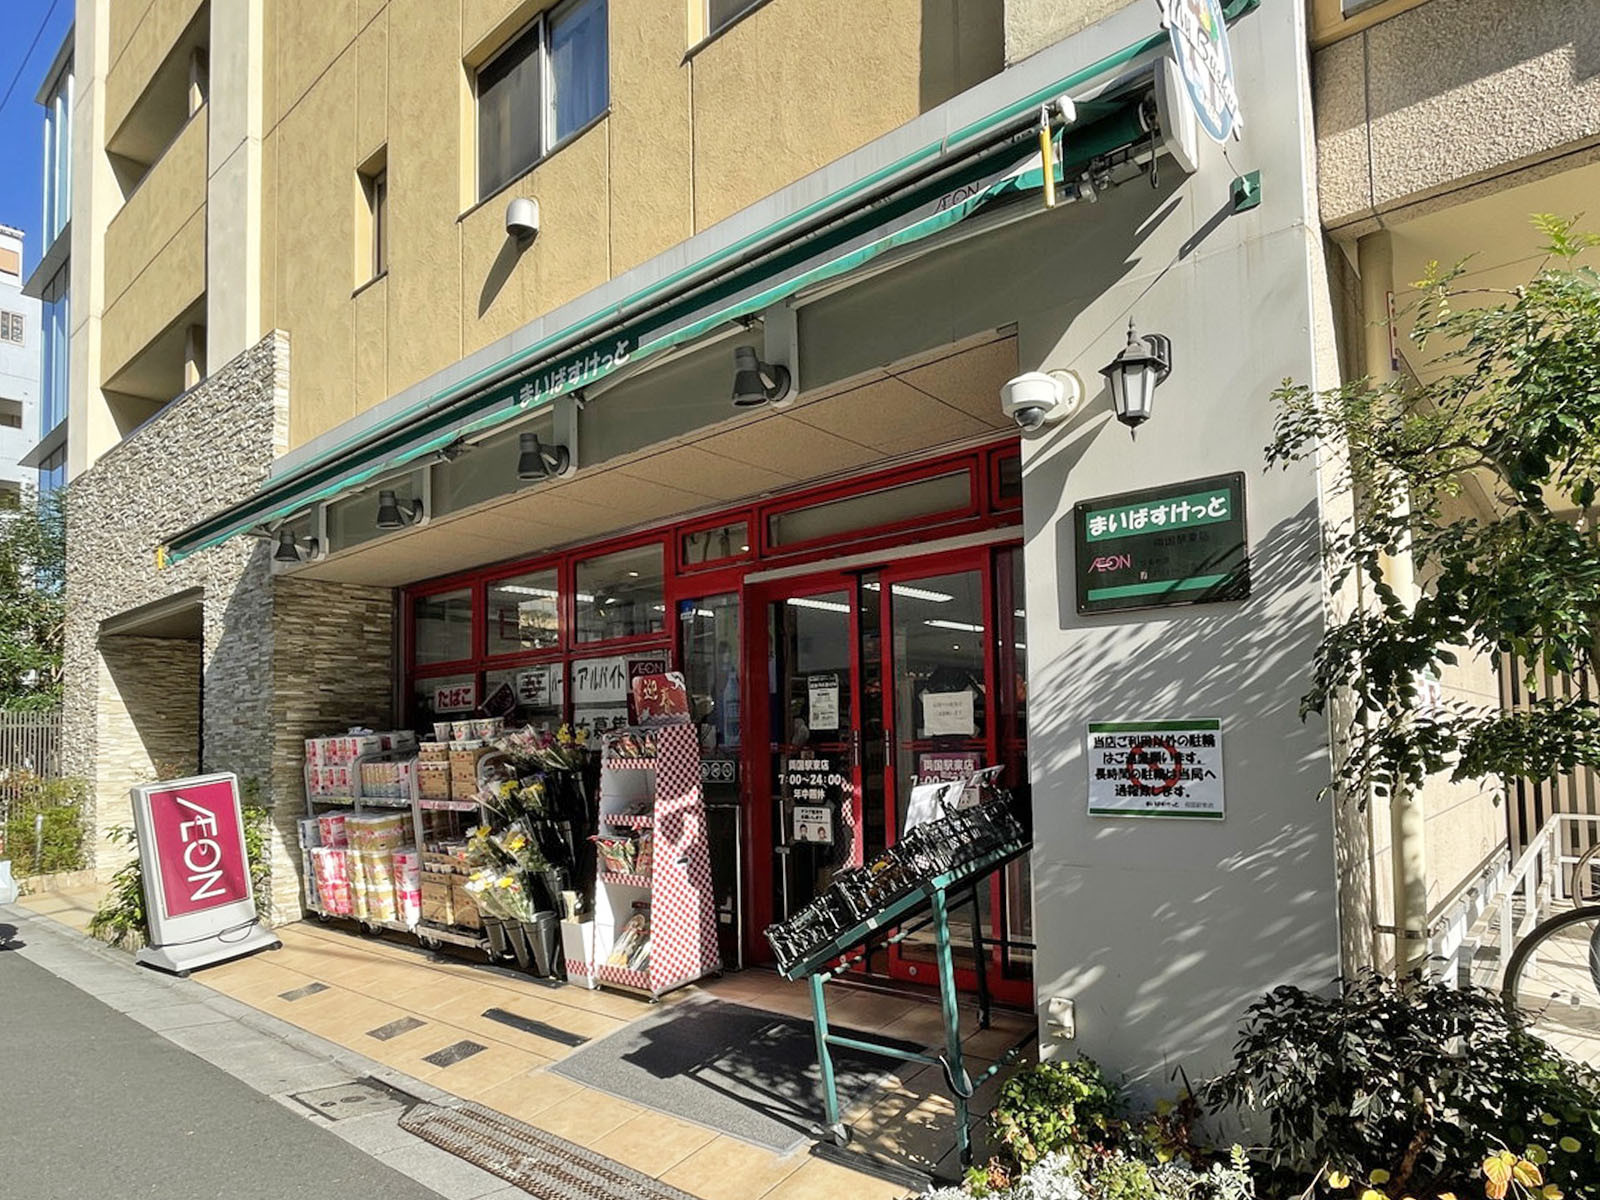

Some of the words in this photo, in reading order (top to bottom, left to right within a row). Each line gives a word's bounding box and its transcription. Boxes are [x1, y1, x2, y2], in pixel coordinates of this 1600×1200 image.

[519, 340, 630, 408] まいばすけっと
[1088, 496, 1228, 536] まいばすけっと
[437, 687, 472, 707] たばこ
[1093, 734, 1216, 749] 当店ご利用以外の駐輪
[923, 759, 975, 771] 両国駅東店
[1095, 768, 1217, 781] 長時間の駐輪は当局へ
[176, 797, 226, 901] AEON
